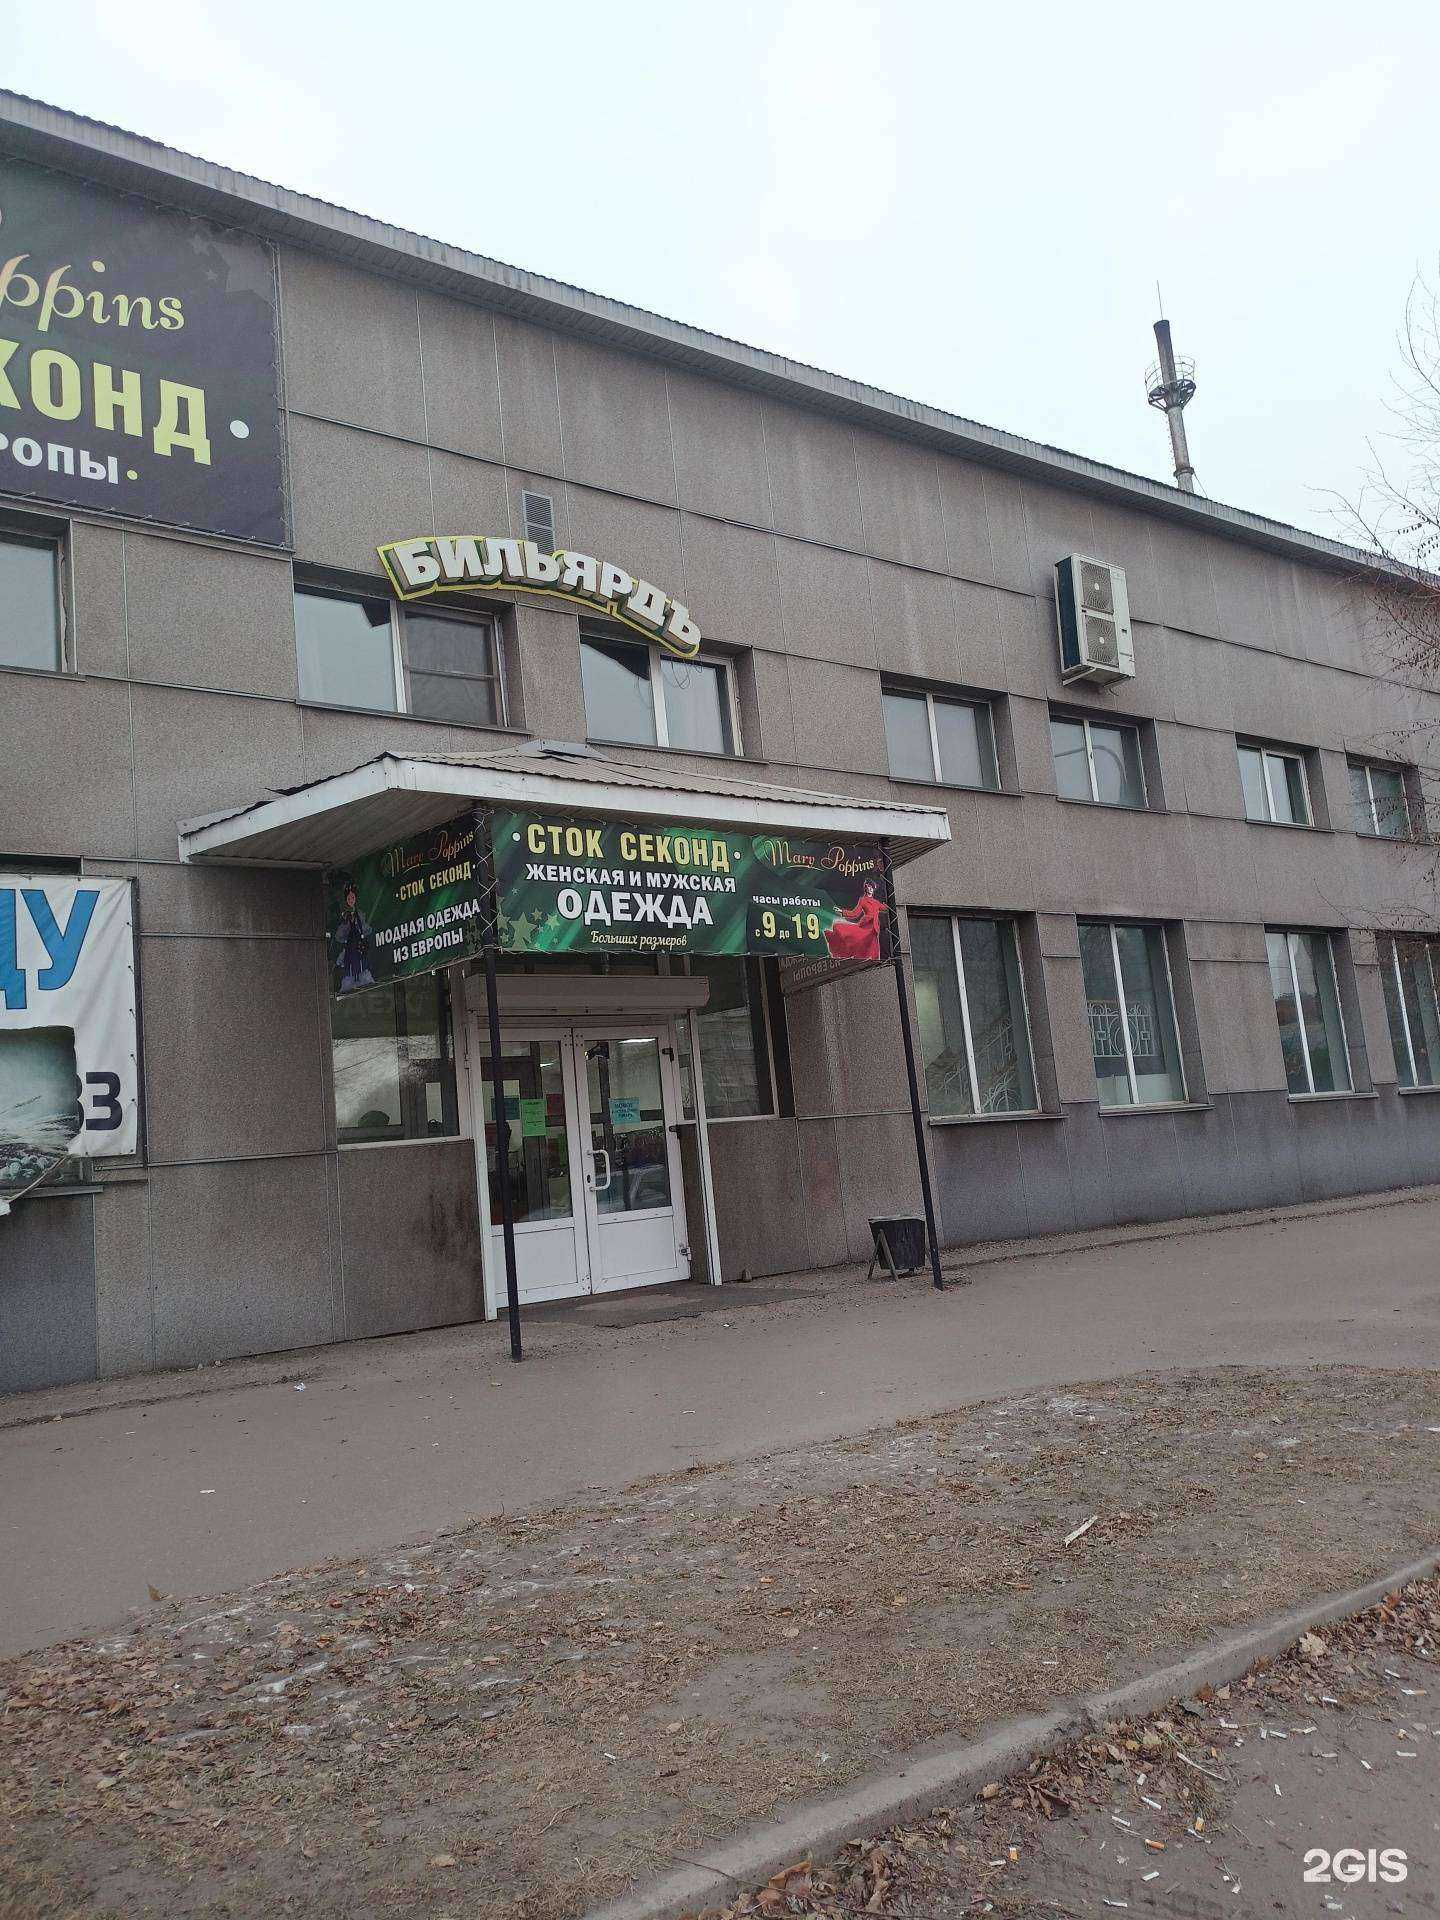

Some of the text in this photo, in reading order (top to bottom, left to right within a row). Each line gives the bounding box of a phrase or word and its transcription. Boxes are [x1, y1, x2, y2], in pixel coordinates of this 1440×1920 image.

[392, 538, 701, 646] БИЛЬЯРДЪ
[526, 823, 730, 873] СТОК СЕКОНД
[763, 840, 875, 877] Mary Poppins
[400, 861, 472, 901] СТОК СЕКОНД
[526, 864, 736, 893] ЖЕНСКАЯ И МУЖСКАЯ
[556, 887, 714, 930] ОДЕЖДА
[752, 895, 821, 907] часы работы
[375, 898, 481, 948] МОДНАЯ ОДЕЖДА
[591, 930, 687, 951] Больших размеров
[762, 911, 776, 938] 9
[779, 929, 790, 940] до
[791, 913, 820, 940] 19
[393, 928, 464, 963] ИЗ ЕВРОПЫ
